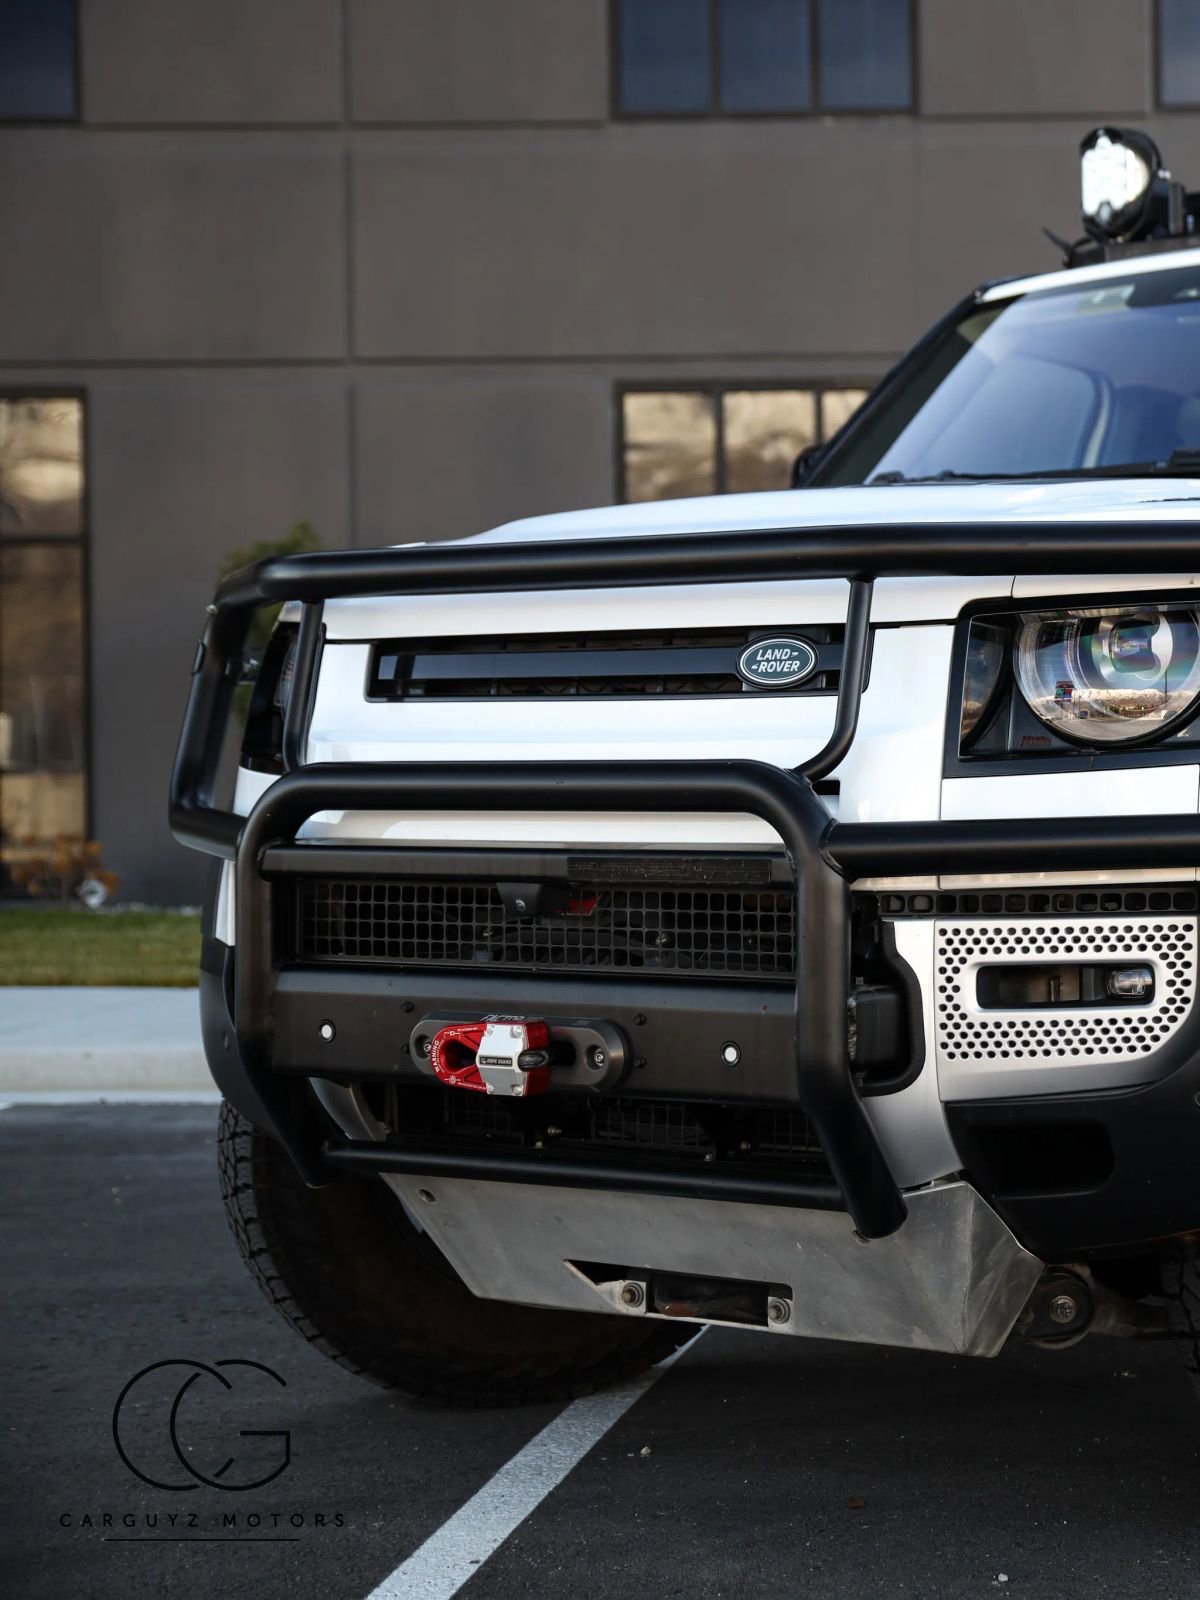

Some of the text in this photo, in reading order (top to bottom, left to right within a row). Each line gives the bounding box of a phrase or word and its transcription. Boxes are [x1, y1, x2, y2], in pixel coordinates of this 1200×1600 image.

[756, 648, 791, 661] LAND
[757, 660, 800, 673] ROVER
[431, 1039, 440, 1073] WARNING
